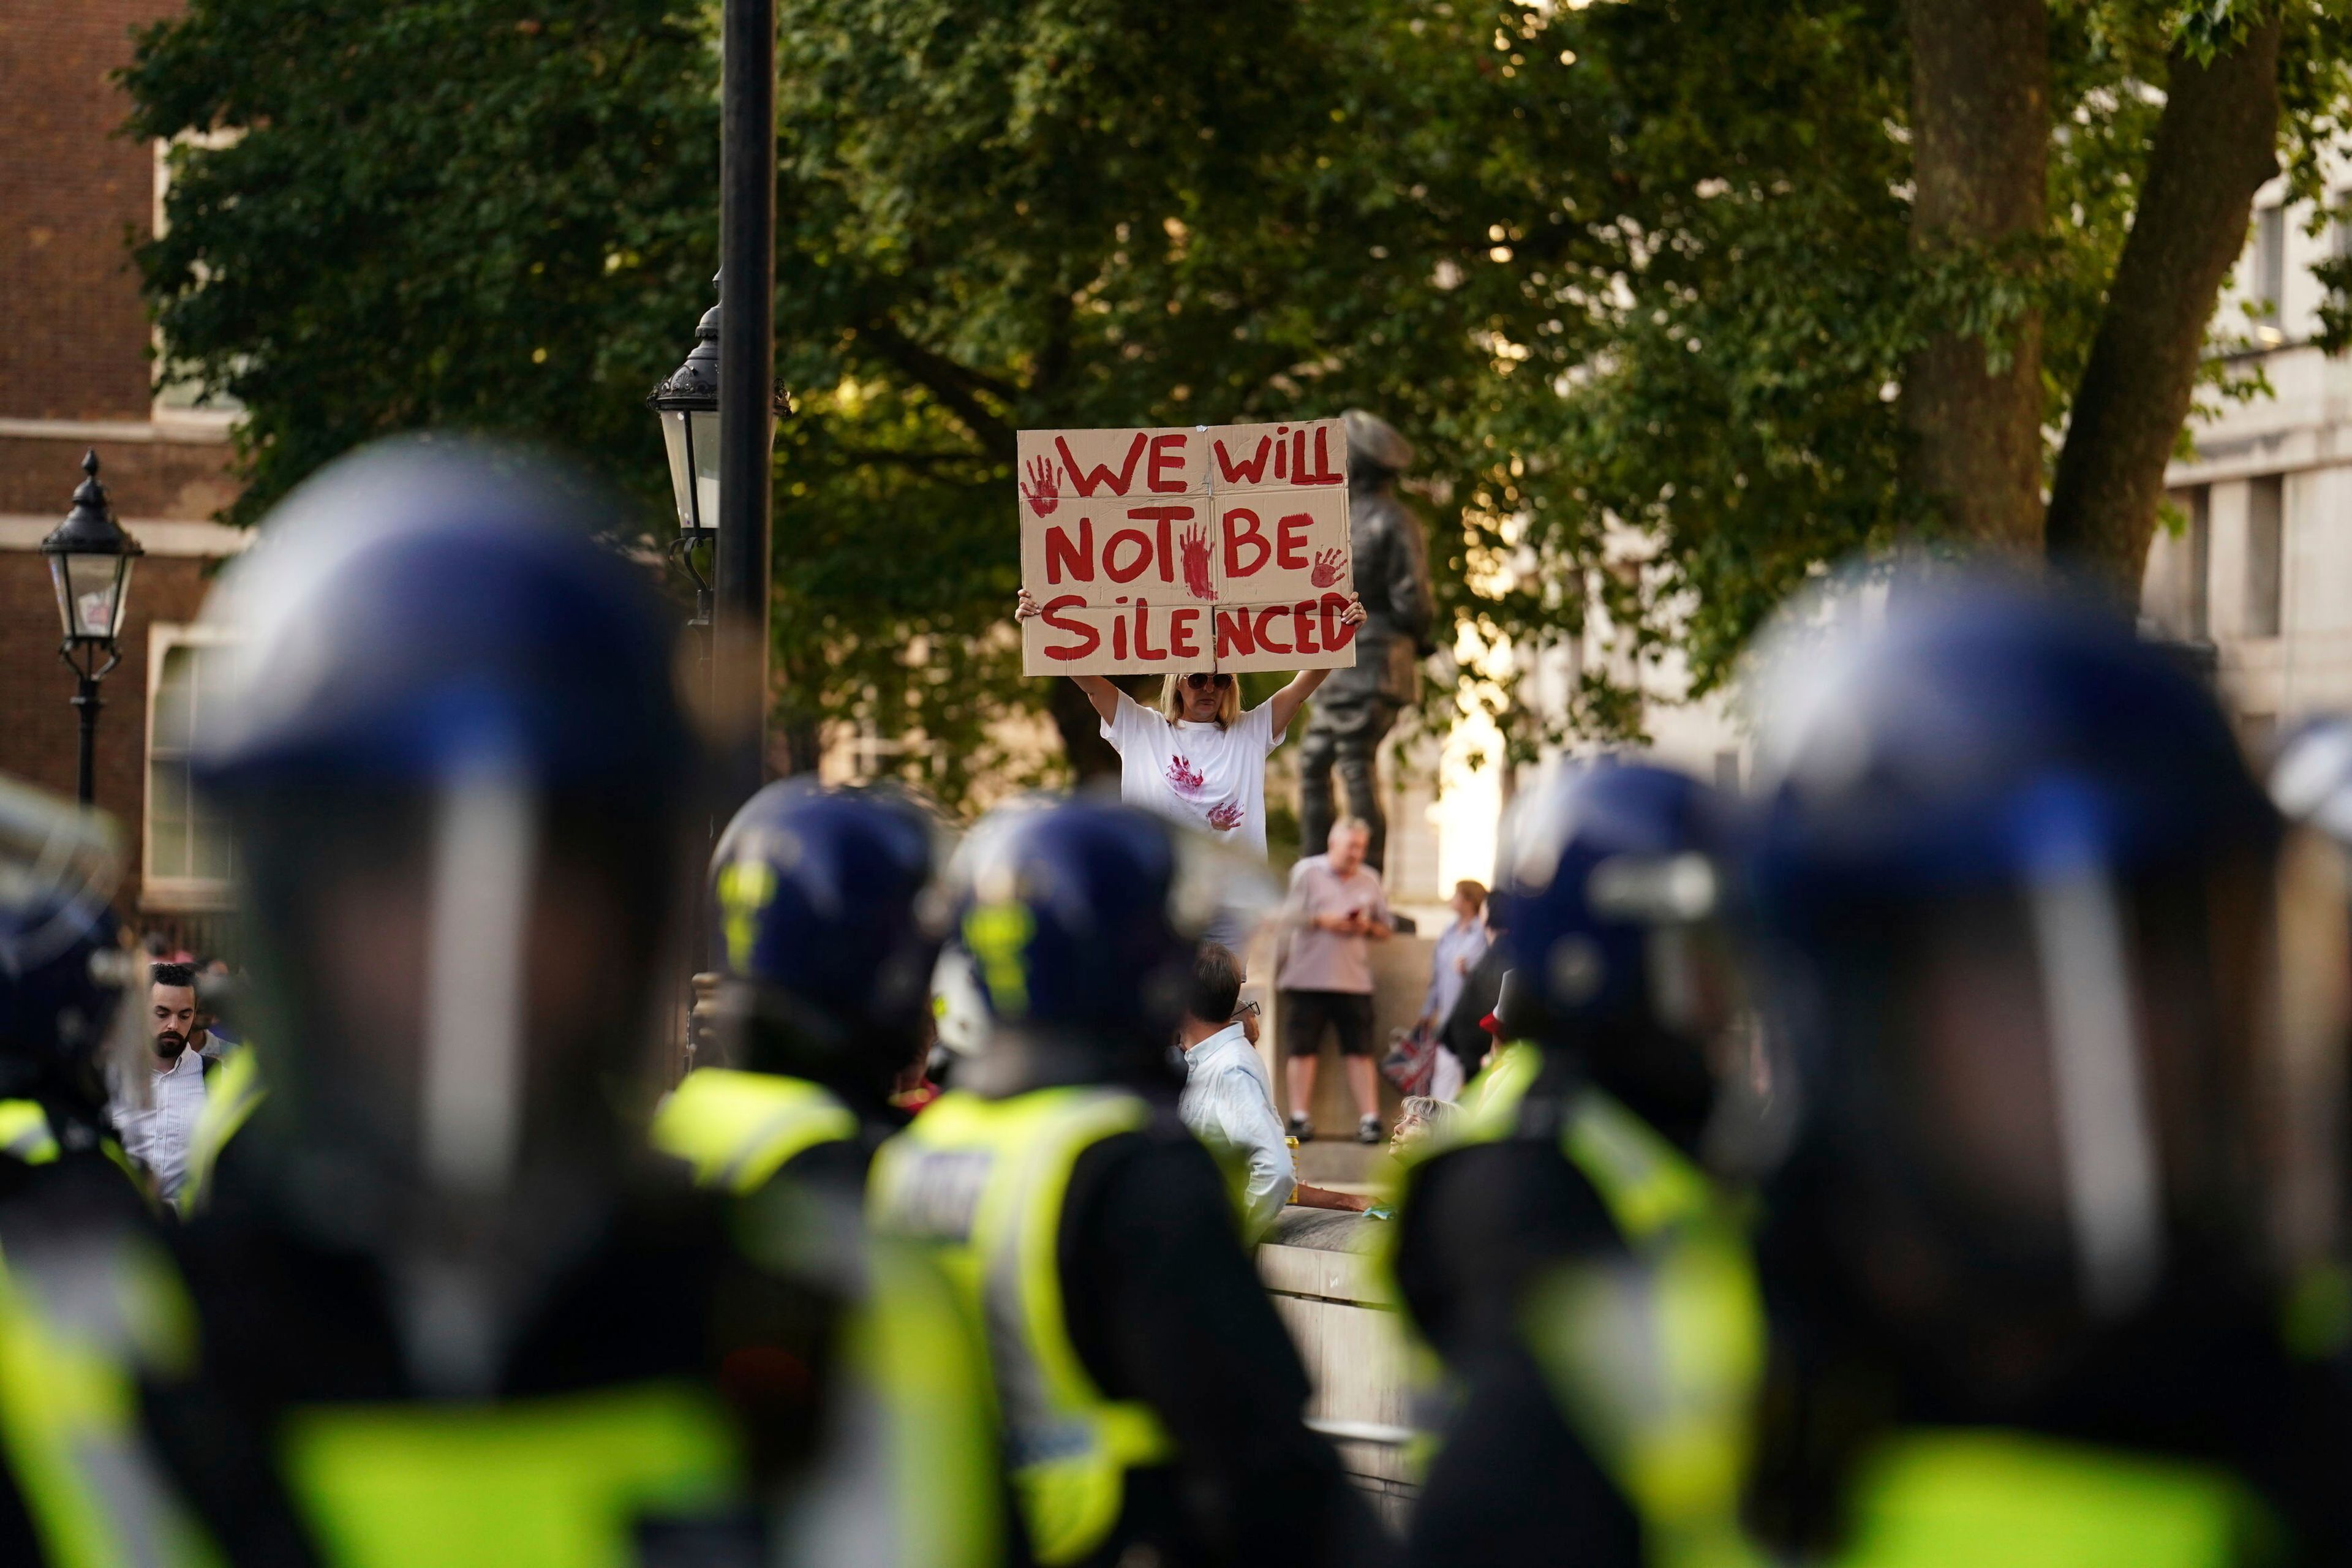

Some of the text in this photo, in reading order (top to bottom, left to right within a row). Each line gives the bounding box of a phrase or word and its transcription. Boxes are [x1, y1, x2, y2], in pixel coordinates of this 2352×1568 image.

[1055, 432, 1188, 497] WE
[1045, 506, 1314, 585] NOT BE
